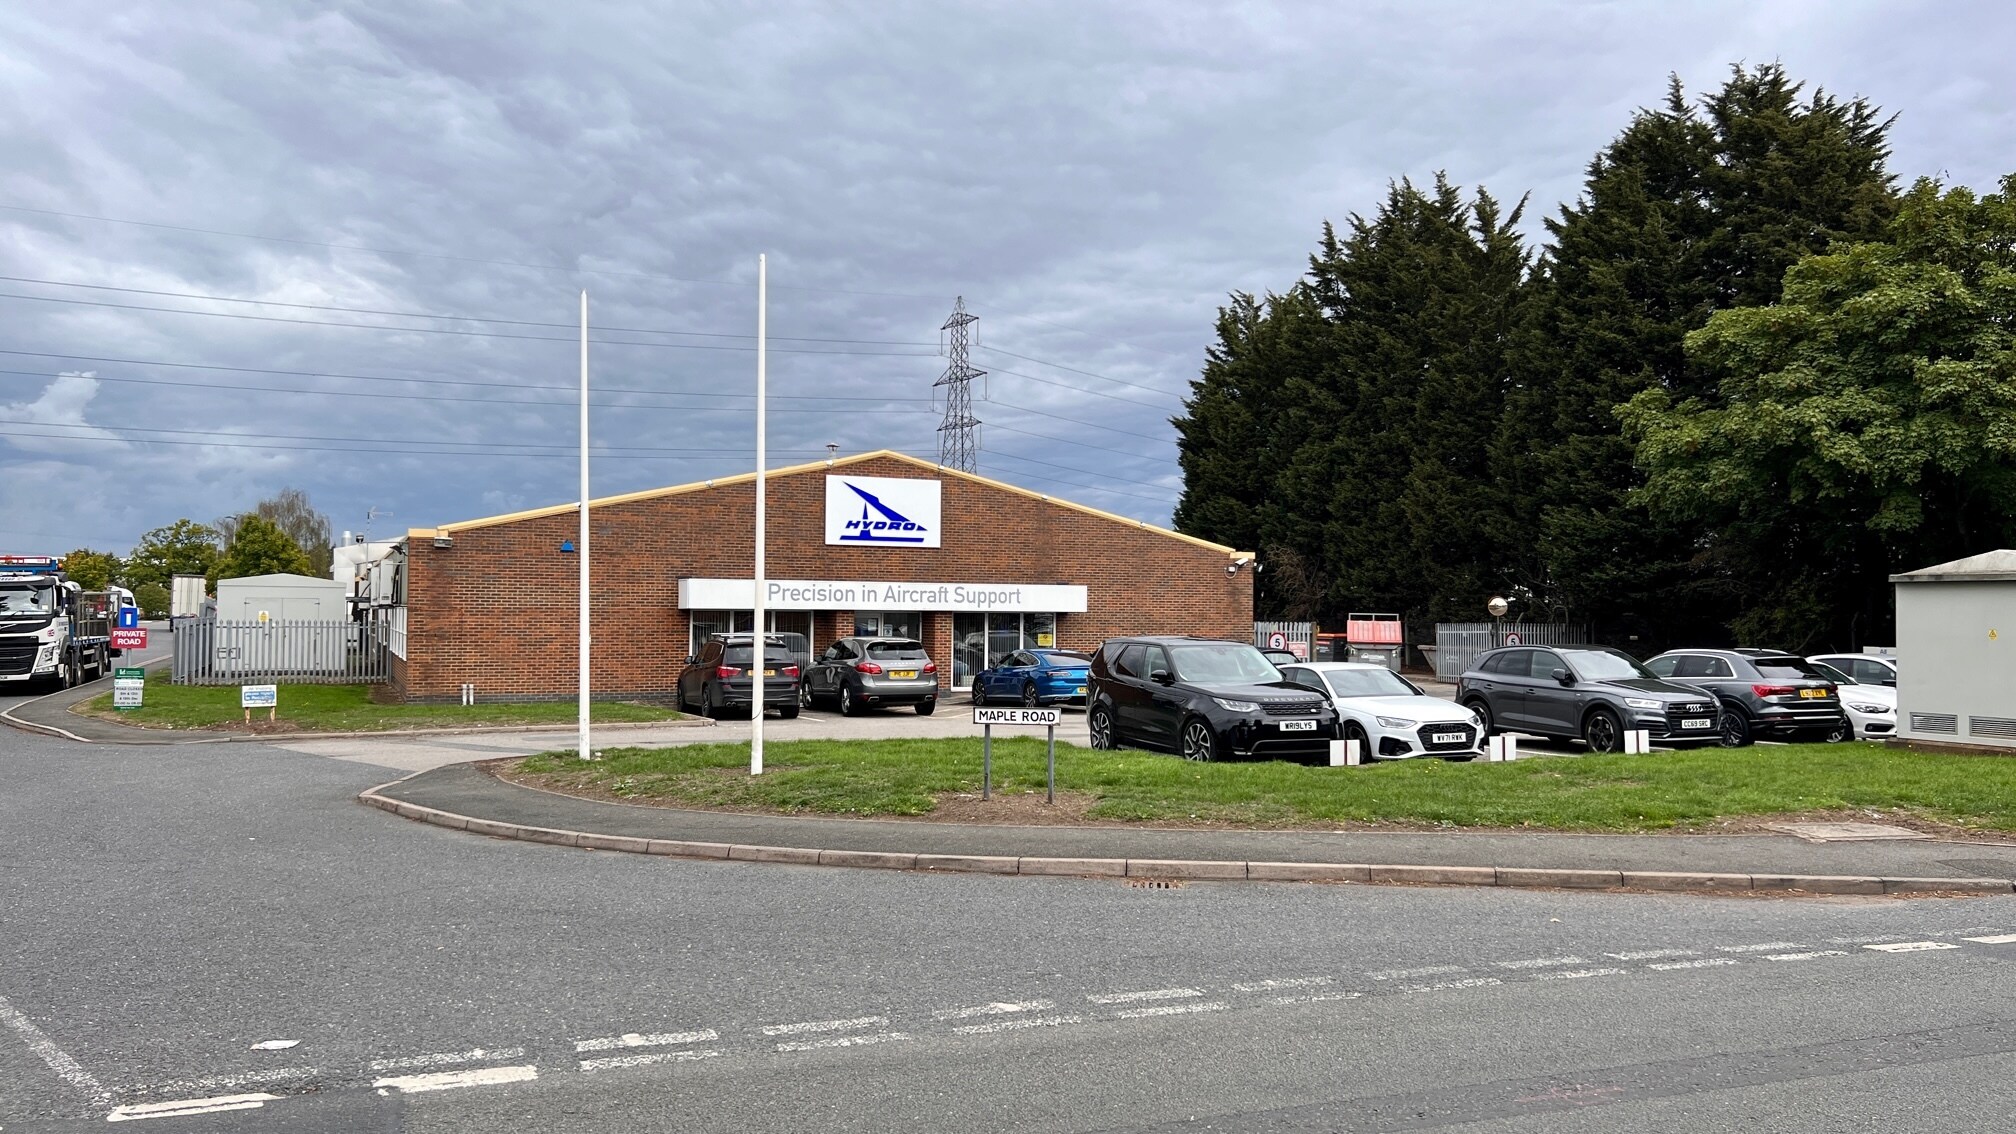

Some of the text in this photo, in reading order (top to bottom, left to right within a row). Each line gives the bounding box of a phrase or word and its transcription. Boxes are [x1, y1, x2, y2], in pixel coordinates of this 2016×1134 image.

[845, 520, 916, 531] HYDRO
[768, 583, 1021, 608] Precision in Aircraft Support
[1274, 638, 1281, 647] 5
[979, 711, 1055, 722] MAPLE ROAD
